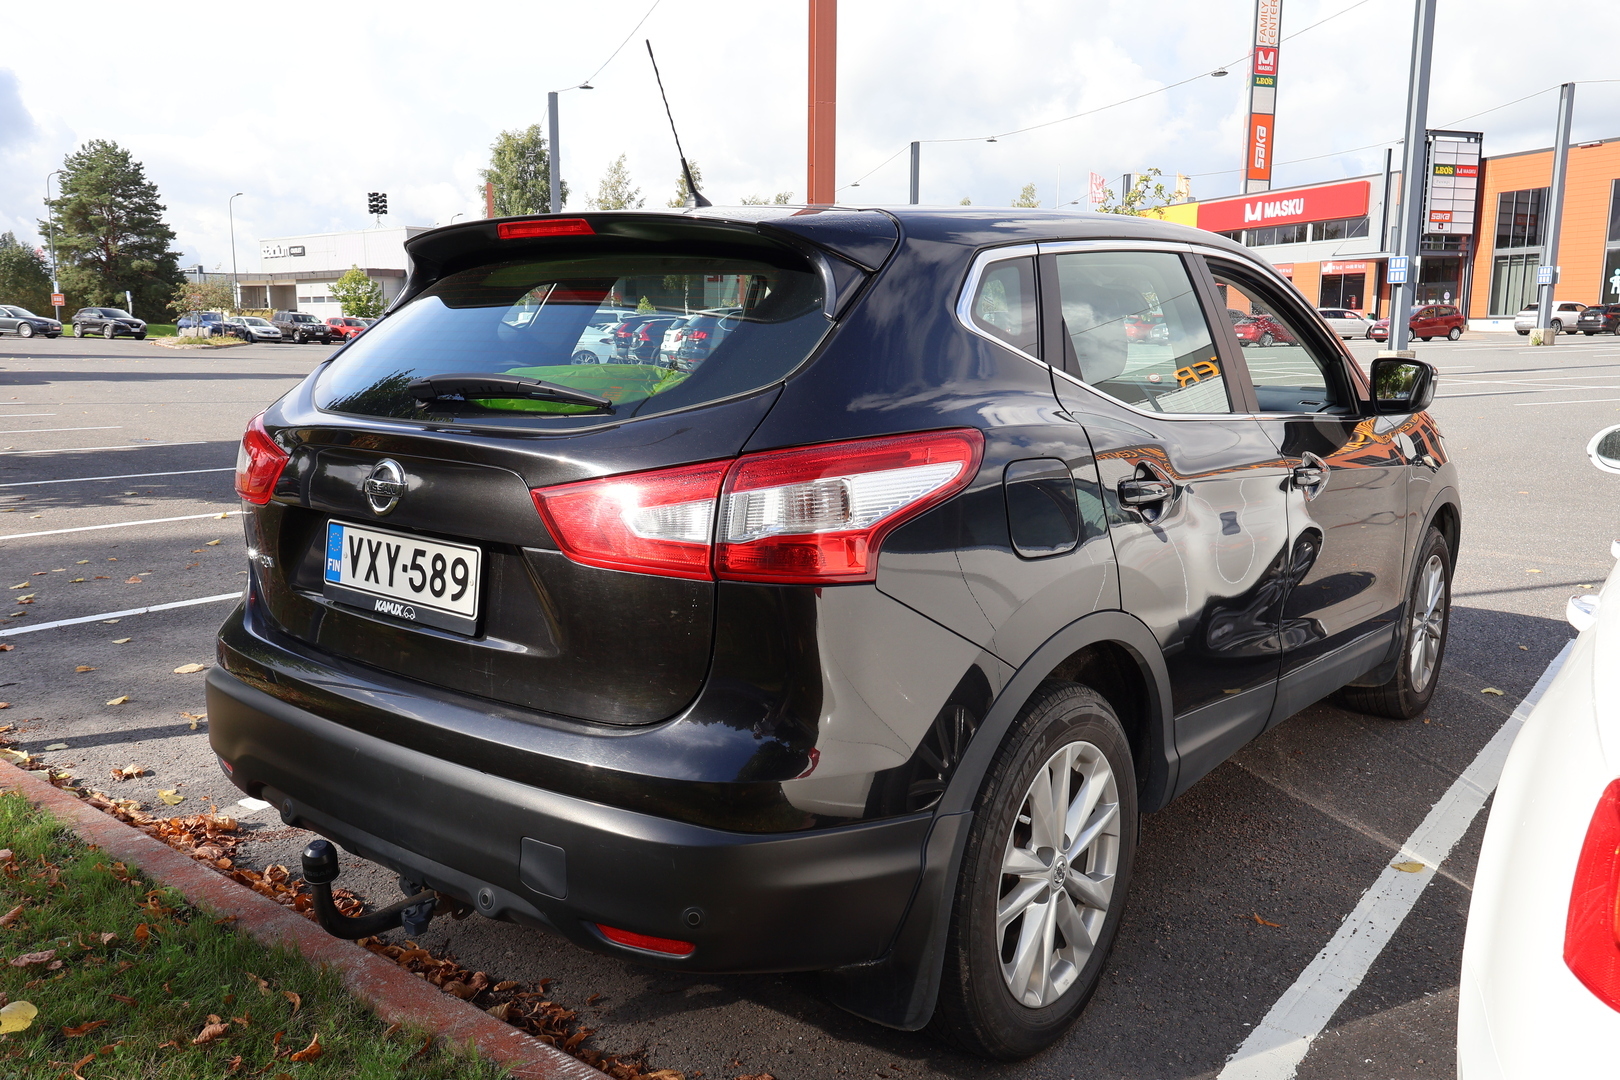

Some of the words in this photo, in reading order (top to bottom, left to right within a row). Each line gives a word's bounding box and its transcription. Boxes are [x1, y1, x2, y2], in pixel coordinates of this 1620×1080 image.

[1260, 2, 1268, 43] FAMILY
[1268, 0, 1278, 45] CENTER
[1256, 77, 1273, 85] LEO'S
[1435, 165, 1453, 175] LEO'S
[1264, 198, 1304, 218] MASKU
[327, 558, 341, 573] FIN
[348, 535, 469, 602] VXY-589
[374, 600, 403, 616] KAMUX
